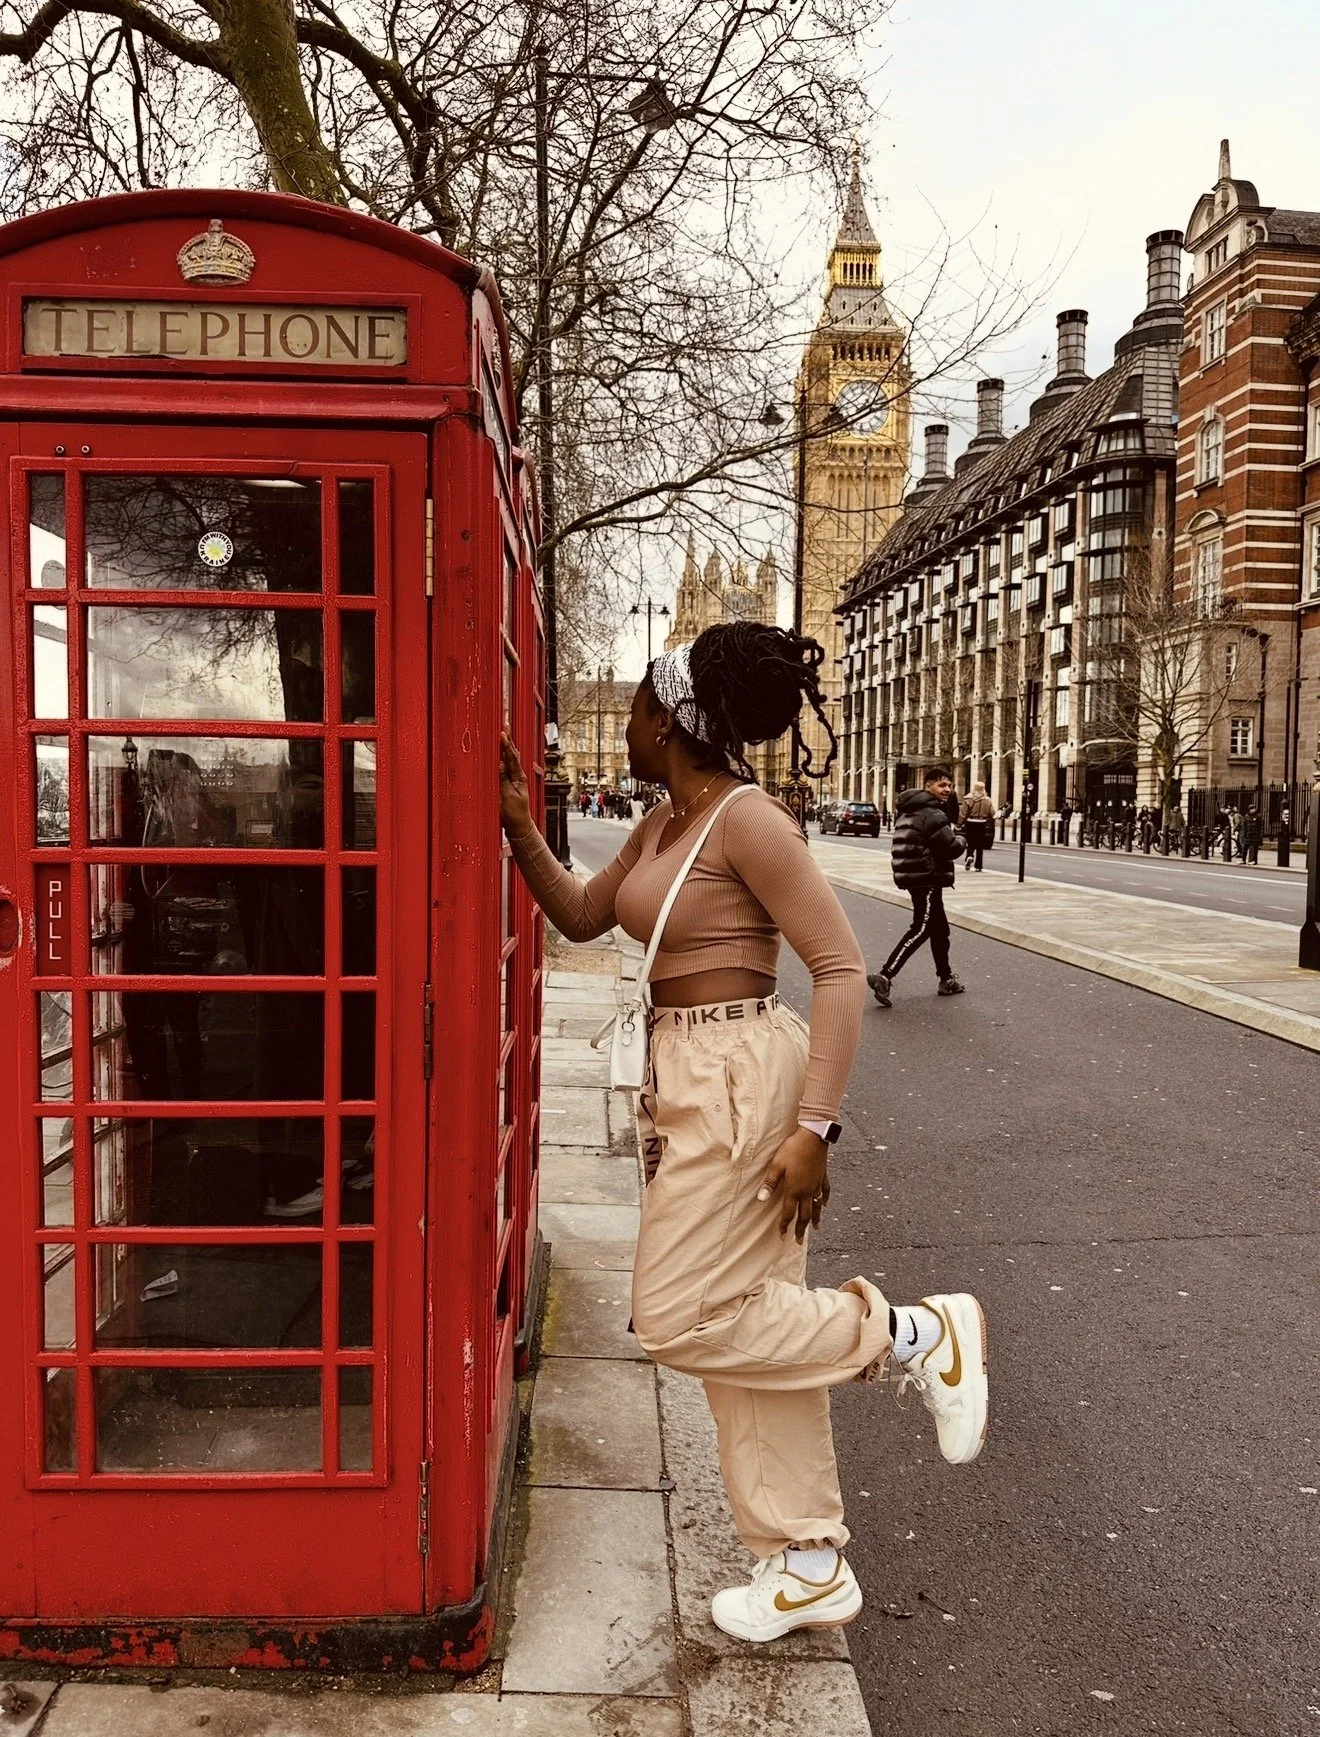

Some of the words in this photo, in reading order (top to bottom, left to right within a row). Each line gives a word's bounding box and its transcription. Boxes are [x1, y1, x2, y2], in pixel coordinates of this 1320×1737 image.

[41, 307, 396, 360] TELEPHONE
[210, 533, 228, 542] WITH
[200, 544, 230, 566] UKRAINE
[49, 881, 61, 959] PULL
[674, 1004, 744, 1026] NIKE
[868, 1362, 880, 1382] AIR
